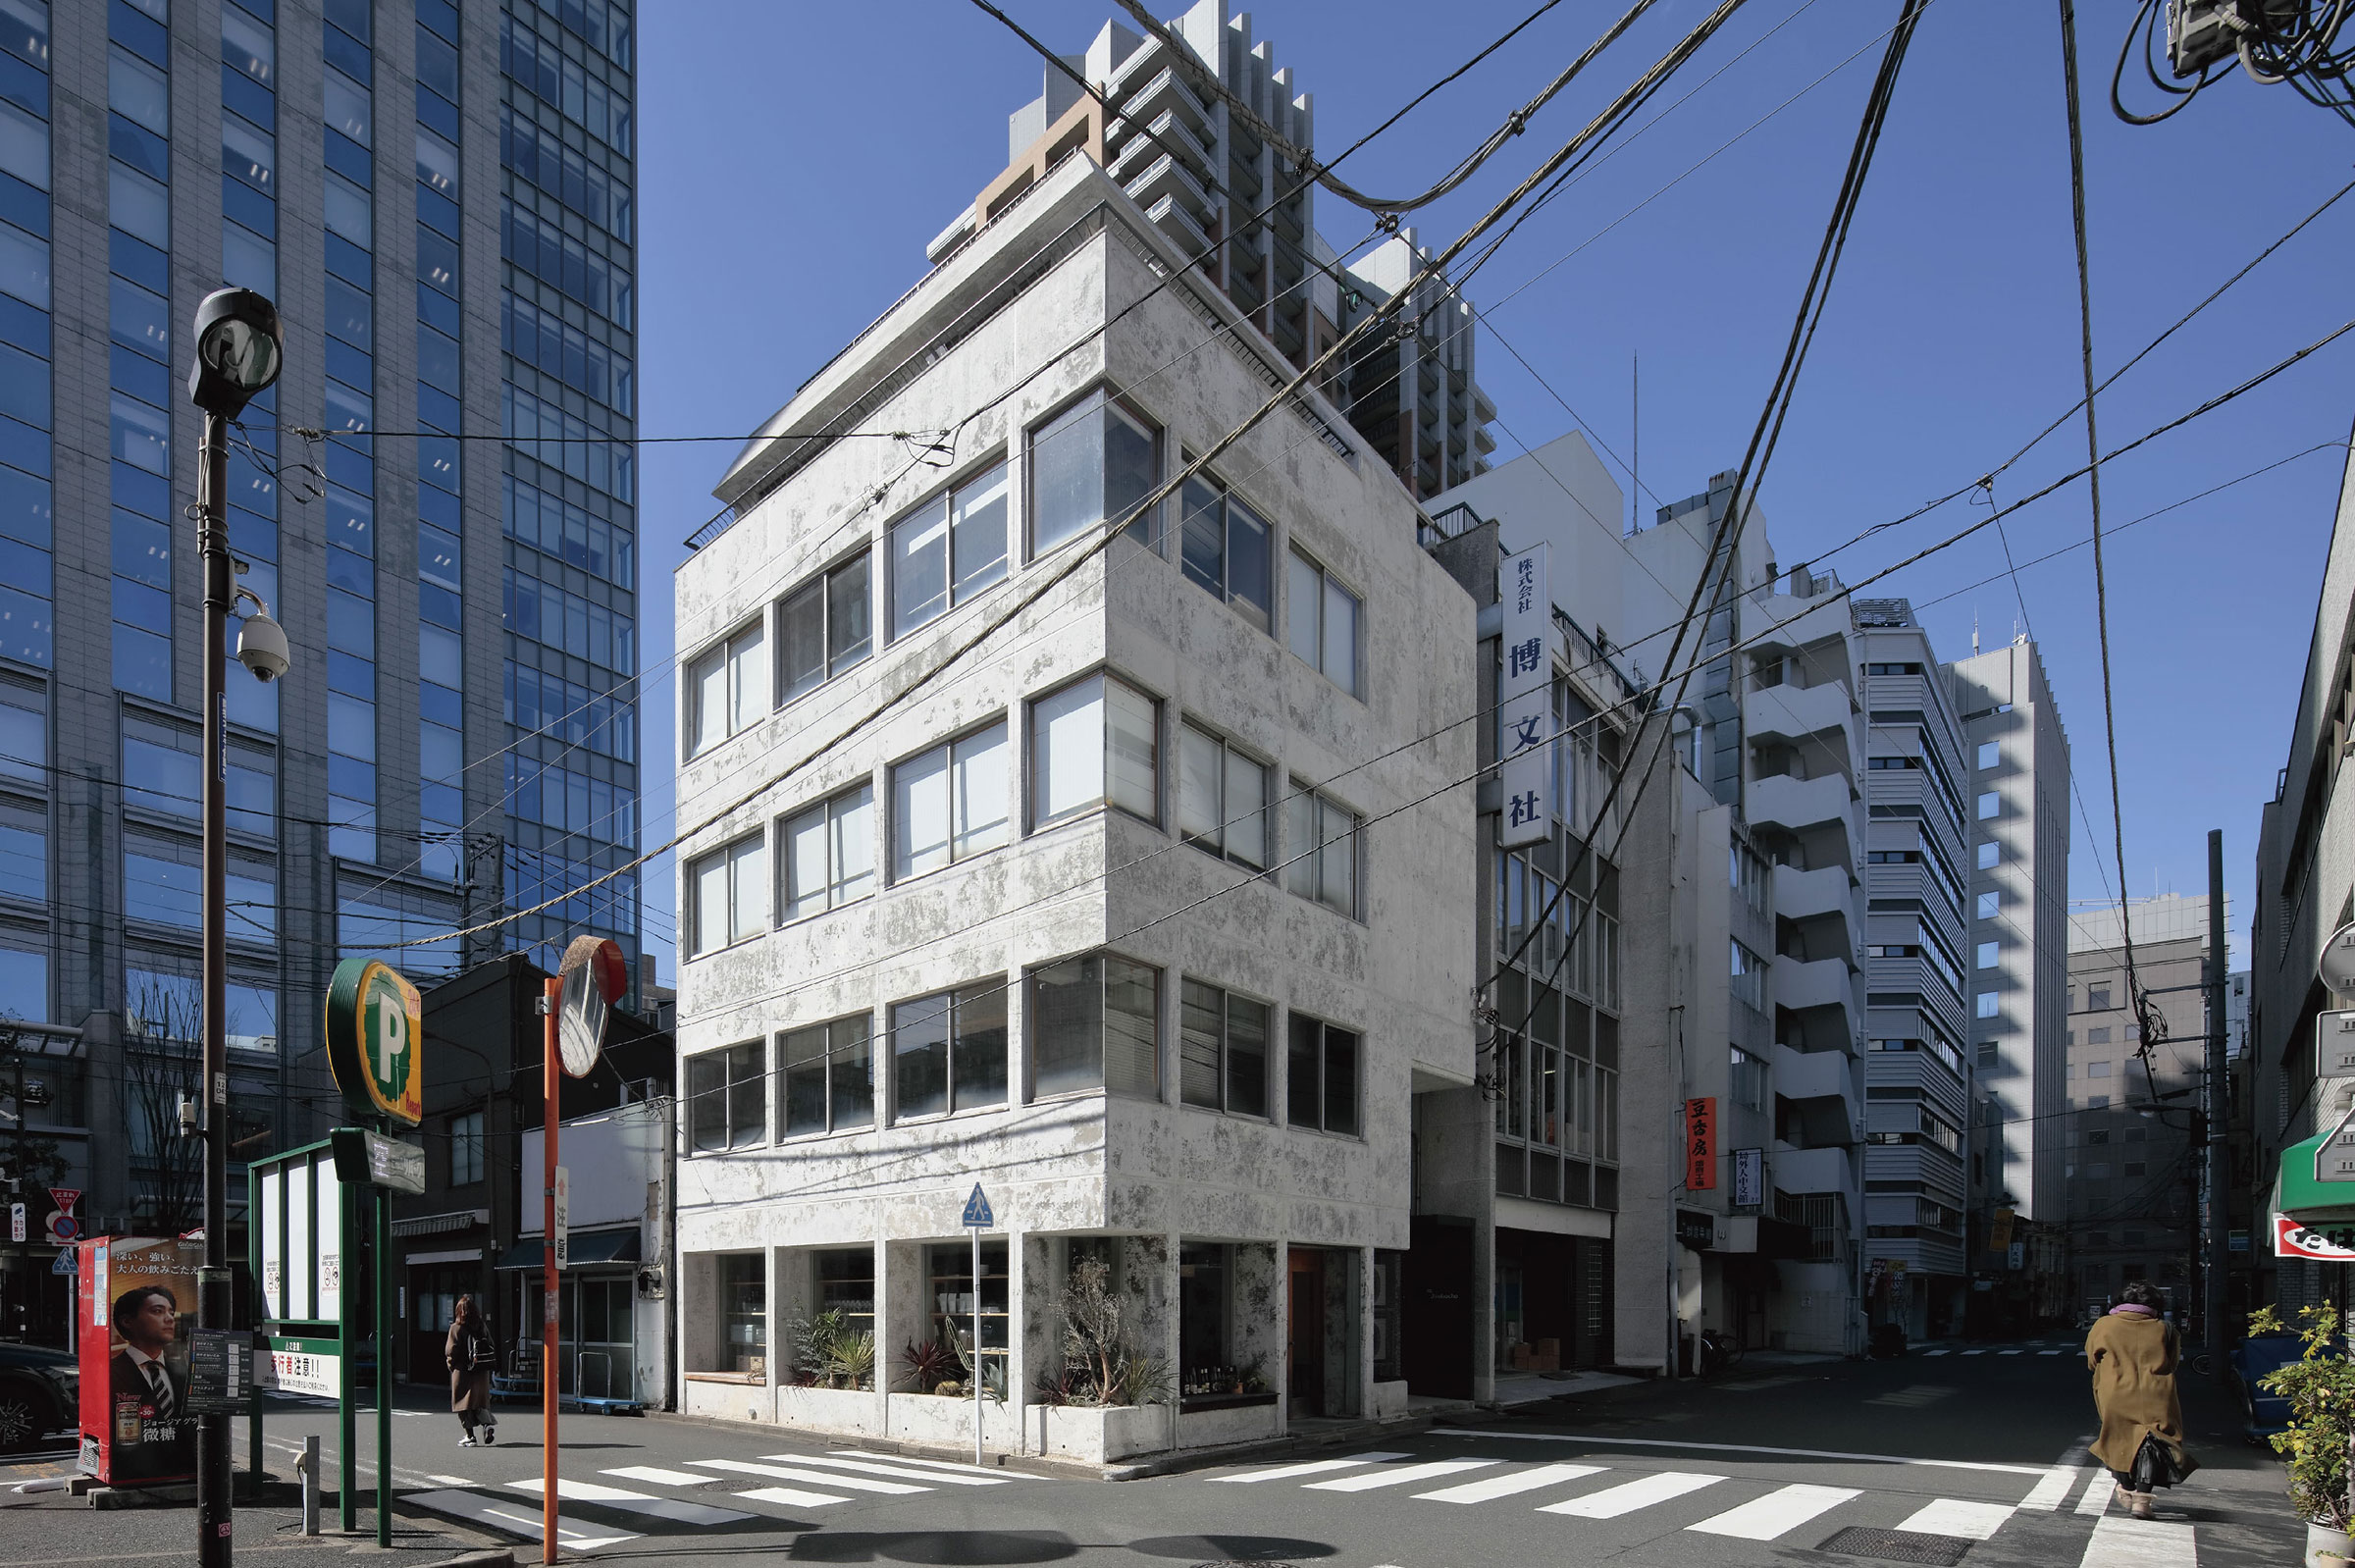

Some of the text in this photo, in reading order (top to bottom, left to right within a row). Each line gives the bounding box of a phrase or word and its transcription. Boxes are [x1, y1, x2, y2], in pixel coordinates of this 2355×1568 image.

[1509, 556, 1542, 829] 株式会社 博文社
[378, 990, 406, 1083] P
[1691, 1100, 1708, 1156] 豆香房
[270, 1354, 320, 1379] 歩行者注意!!
[142, 1418, 182, 1428] ジョージア
[142, 1427, 177, 1442] 微糖
